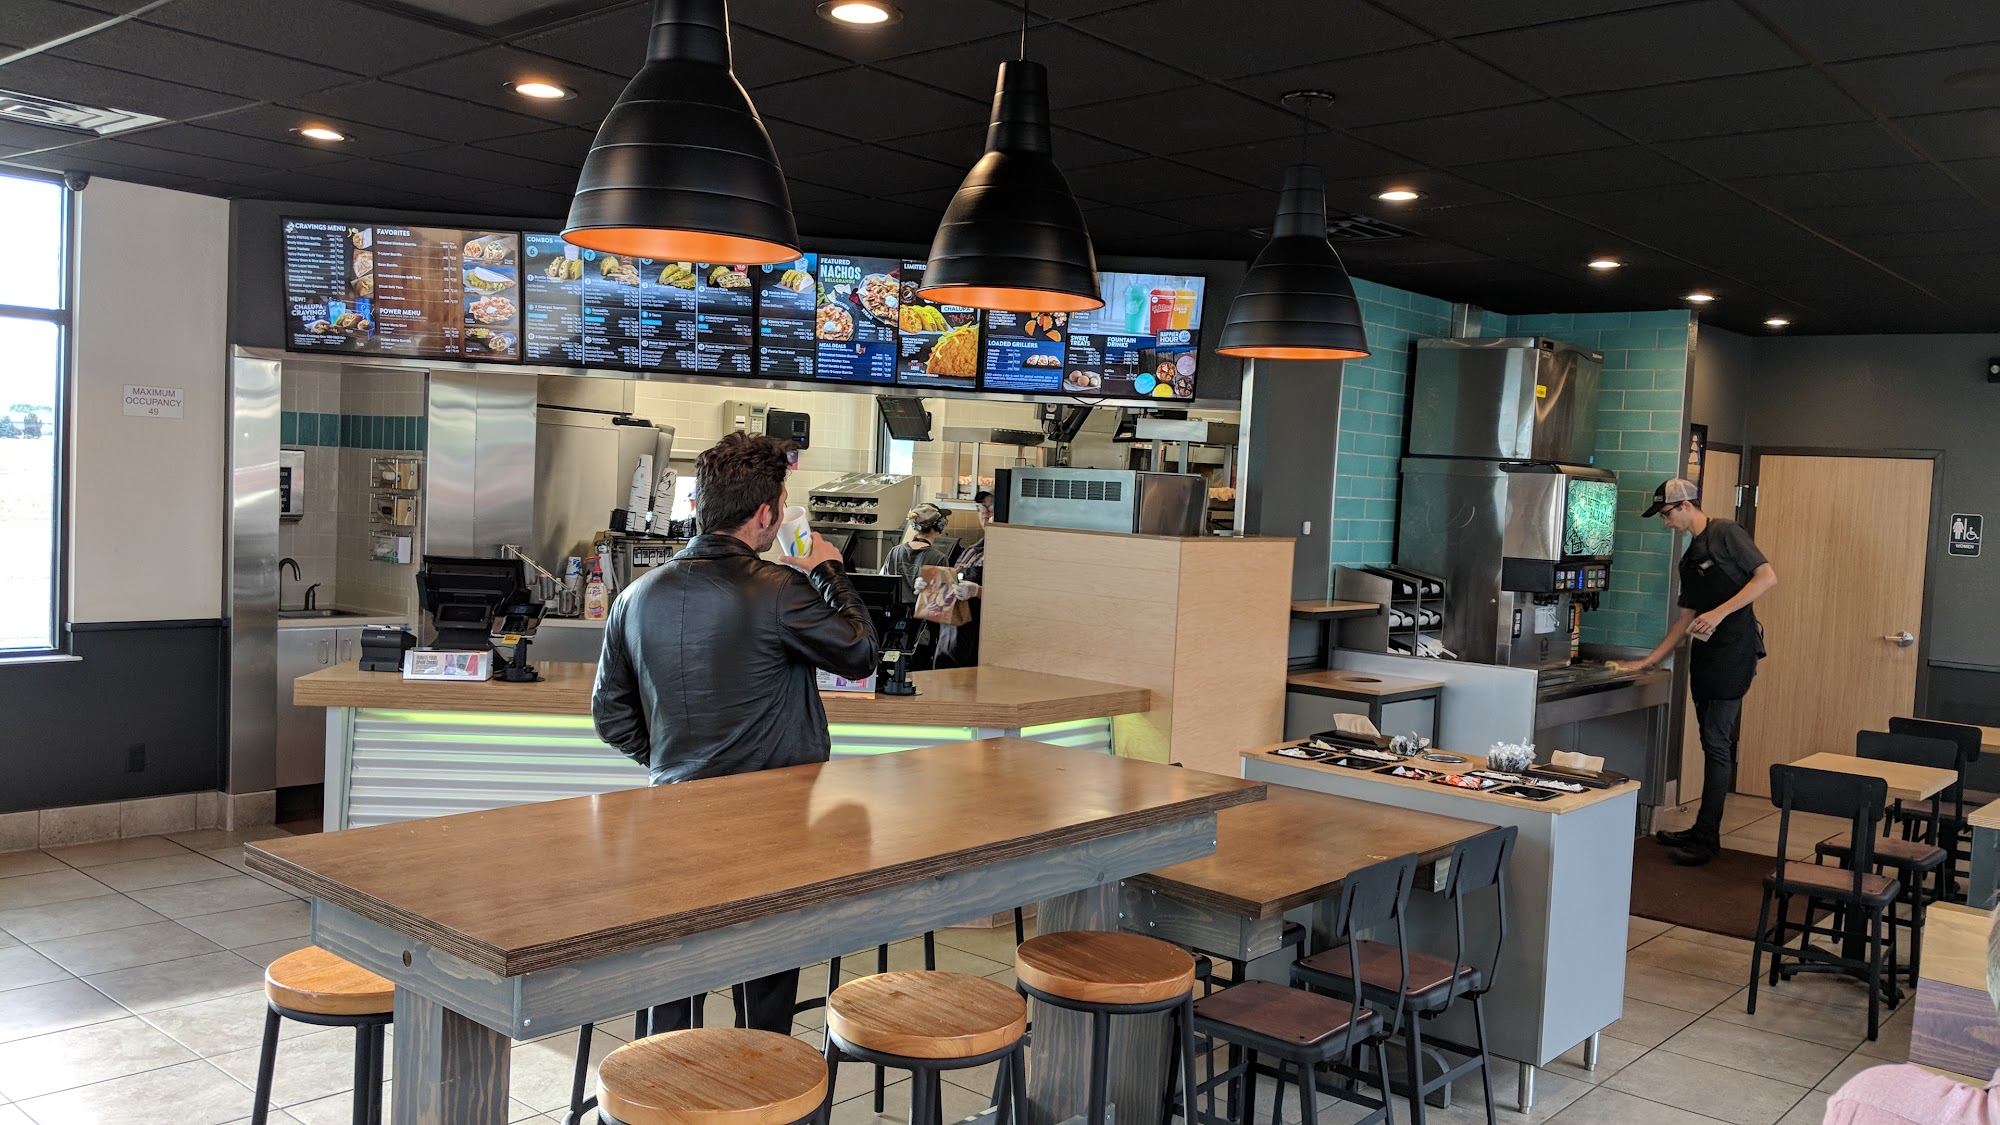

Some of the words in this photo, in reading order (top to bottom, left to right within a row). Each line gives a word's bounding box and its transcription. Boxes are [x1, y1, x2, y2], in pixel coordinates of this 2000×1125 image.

[821, 265, 861, 280] NACHOS
[132, 387, 175, 397] MAXIMUM
[125, 396, 182, 407] OCCUPANCY
